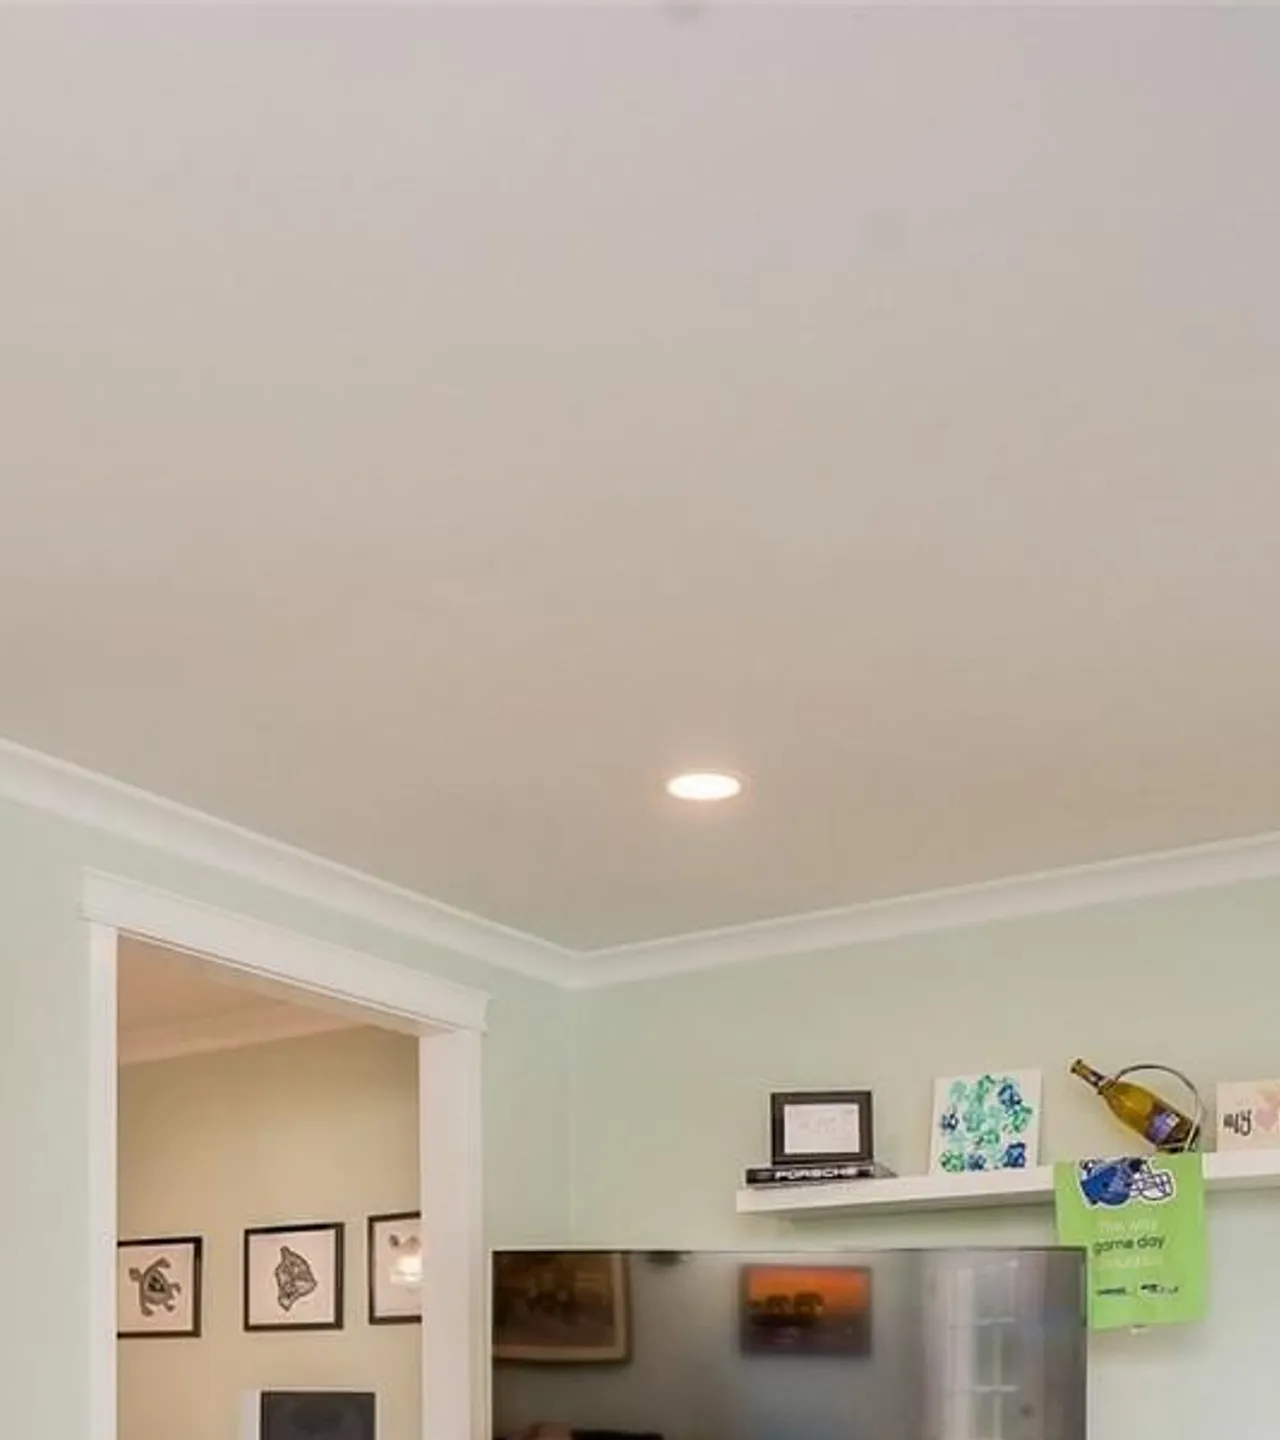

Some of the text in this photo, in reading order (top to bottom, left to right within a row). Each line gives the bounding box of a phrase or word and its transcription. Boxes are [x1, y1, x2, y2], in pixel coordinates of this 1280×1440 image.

[1223, 1109, 1252, 1136] my
[1094, 1234, 1165, 1255] game day
